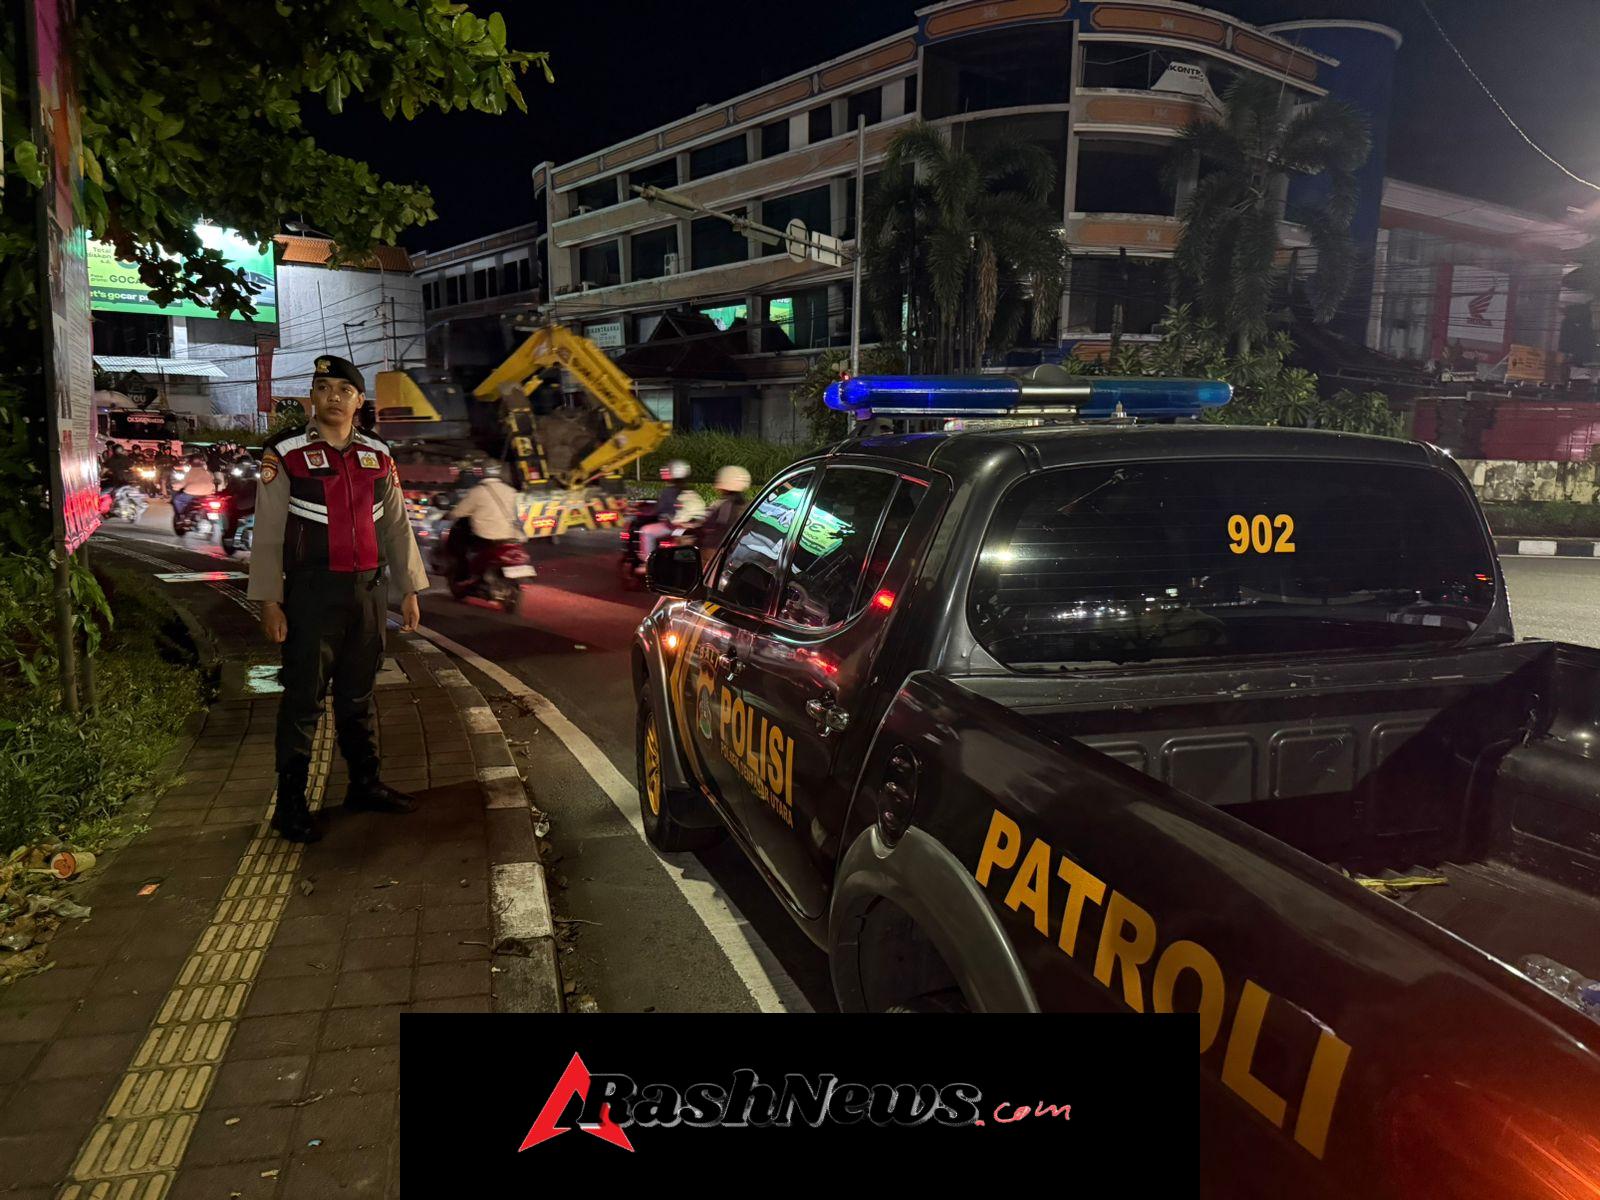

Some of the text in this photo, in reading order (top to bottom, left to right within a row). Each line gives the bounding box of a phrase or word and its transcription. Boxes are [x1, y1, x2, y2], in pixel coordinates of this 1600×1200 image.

[1227, 513, 1296, 554] 902
[720, 685, 794, 807] POLISI
[769, 791, 794, 829] UTARA
[974, 808, 1353, 1161] PATROLI
